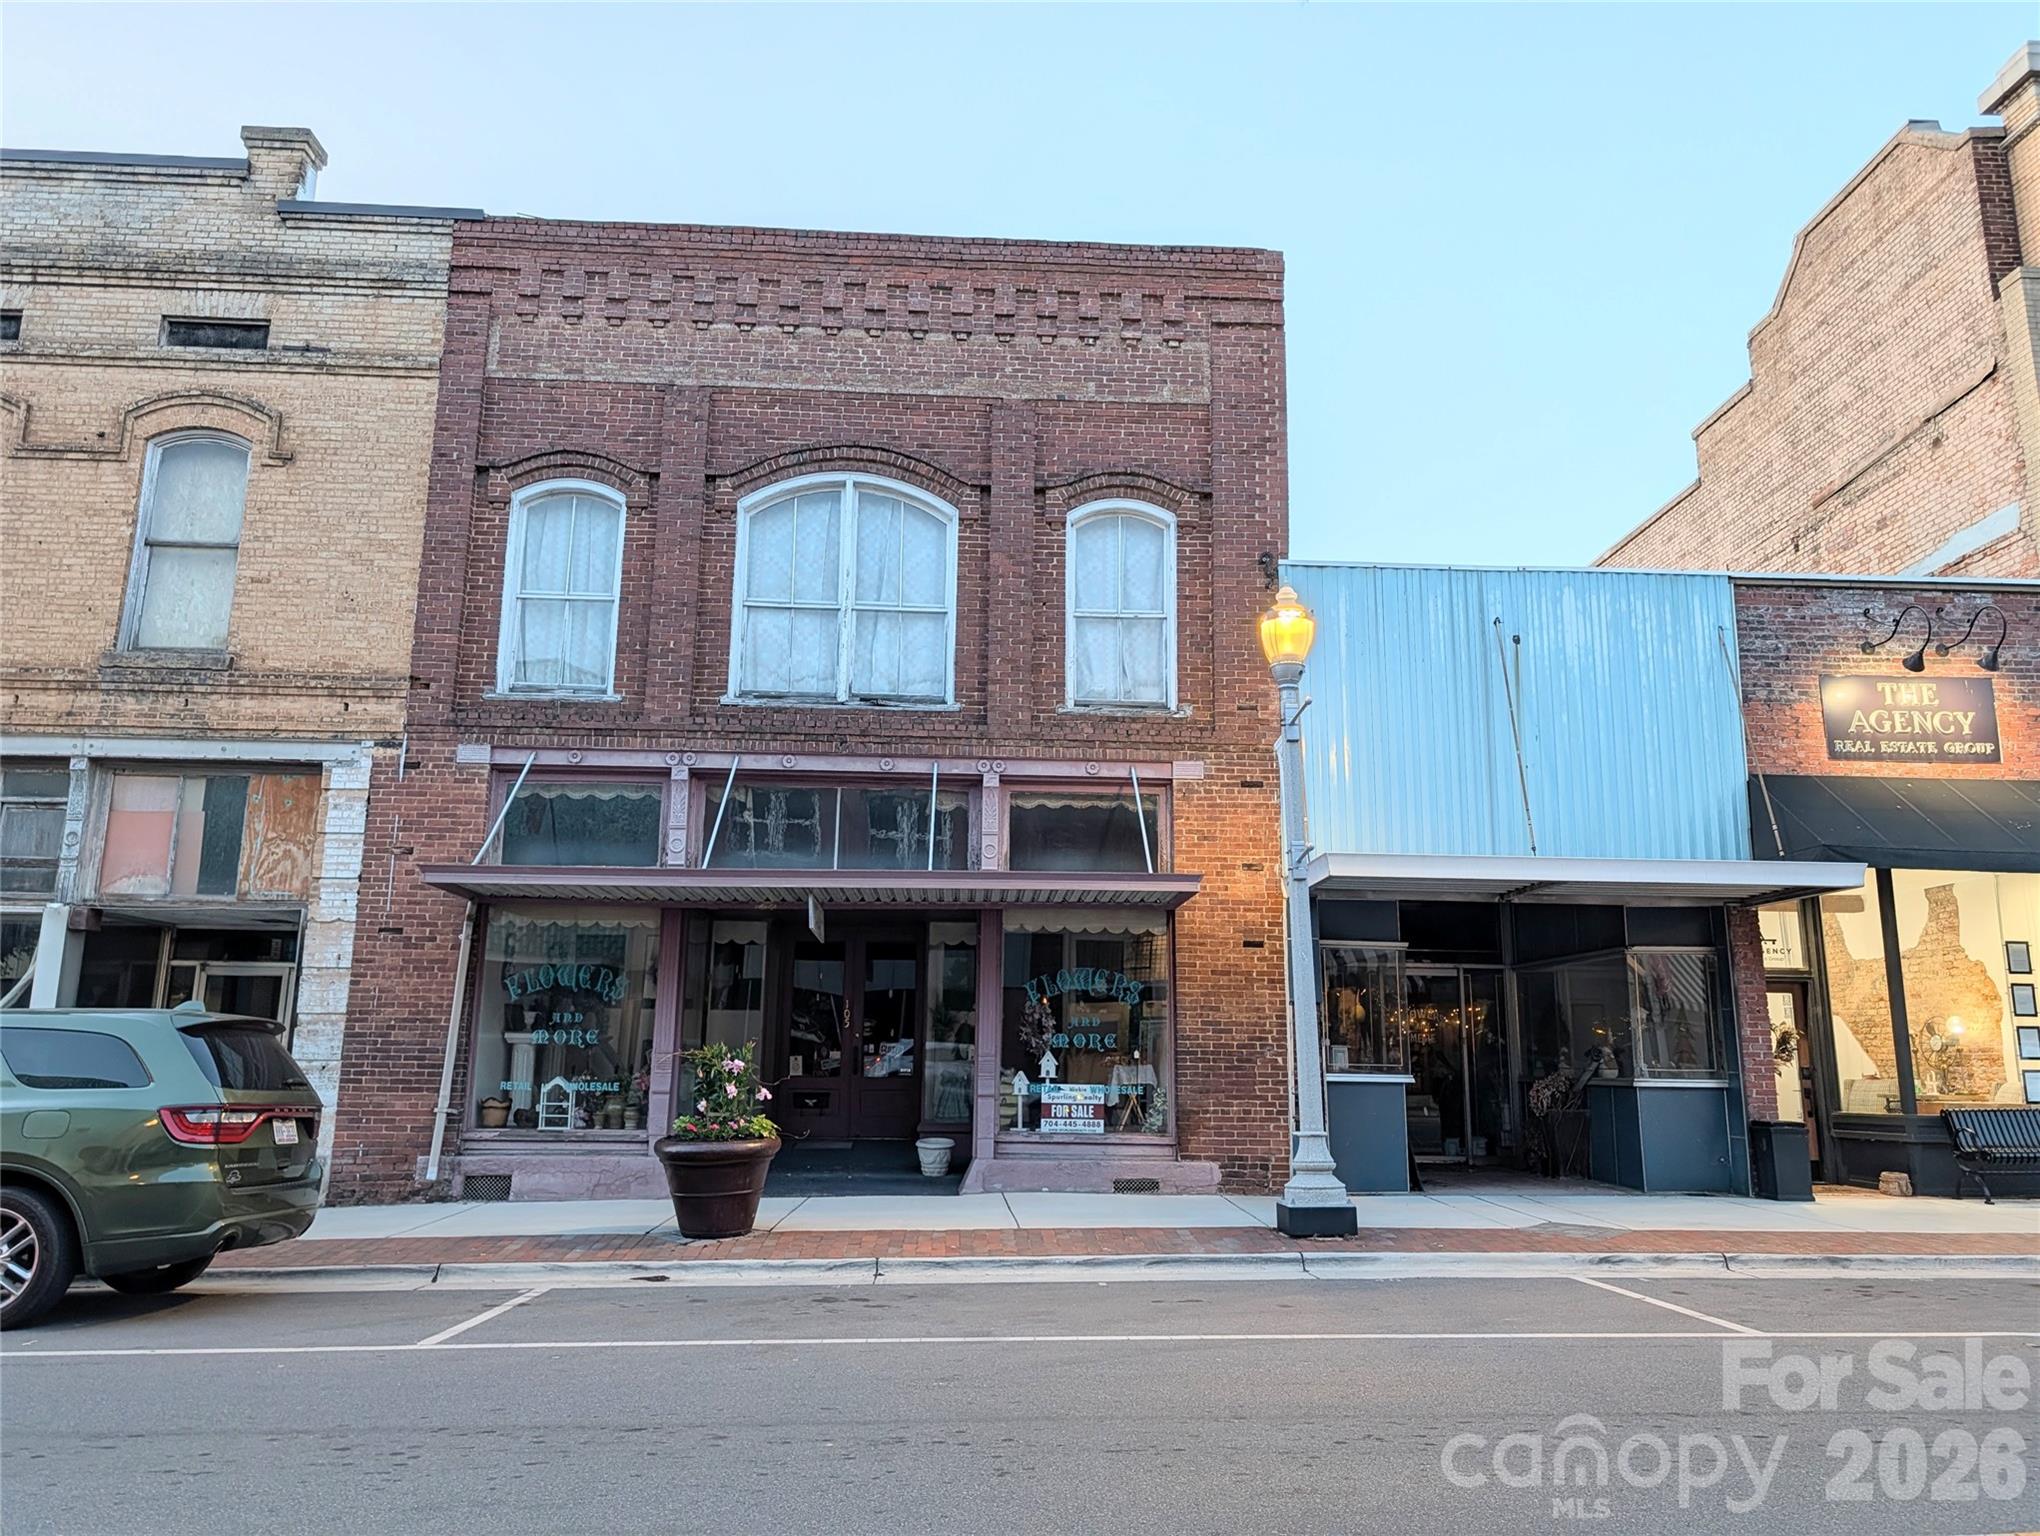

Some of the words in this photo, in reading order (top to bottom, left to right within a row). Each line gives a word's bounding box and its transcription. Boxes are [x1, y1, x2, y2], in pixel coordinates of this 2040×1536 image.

[1876, 682, 1940, 706] THE
[1848, 709, 1976, 735] AGENCY
[1833, 740, 1875, 753] REAL
[1880, 741, 1938, 754] ESTATE
[1943, 742, 1996, 755] GROUP
[504, 964, 630, 1004] FLOWERS
[1024, 967, 1144, 1006] FLOWERS
[549, 1012, 584, 1025] AND
[1067, 1016, 1101, 1029] AND
[531, 1029, 600, 1048] MORE
[1051, 1033, 1117, 1052] MORE
[500, 1081, 532, 1091] RETAIL
[1080, 1094, 1103, 1102] ealty
[1051, 1105, 1069, 1117] FOR
[1071, 1105, 1095, 1118] SALE
